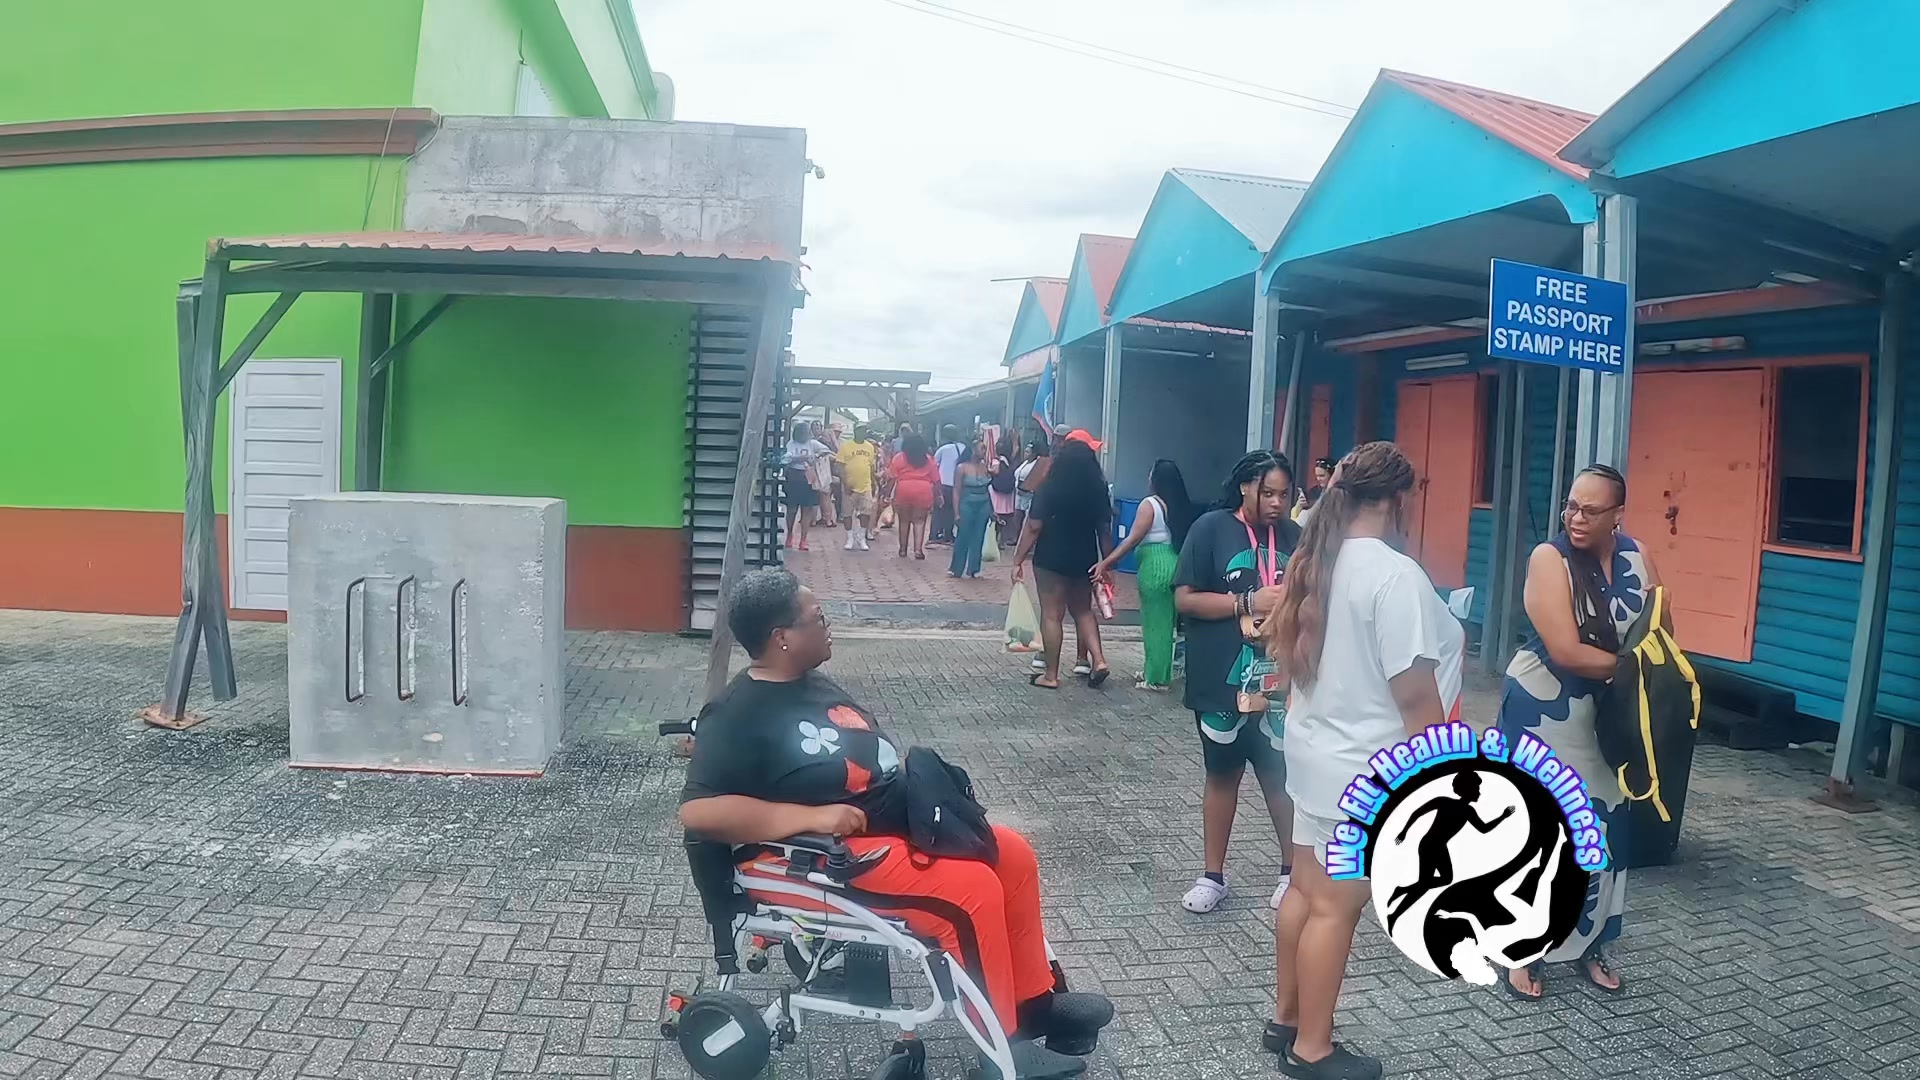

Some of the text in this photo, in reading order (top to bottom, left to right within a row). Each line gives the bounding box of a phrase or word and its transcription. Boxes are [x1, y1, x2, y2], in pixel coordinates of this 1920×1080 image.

[1535, 275, 1588, 304] FREE
[1507, 300, 1613, 336] PASSPORT
[1494, 327, 1622, 366] STAMP HERE
